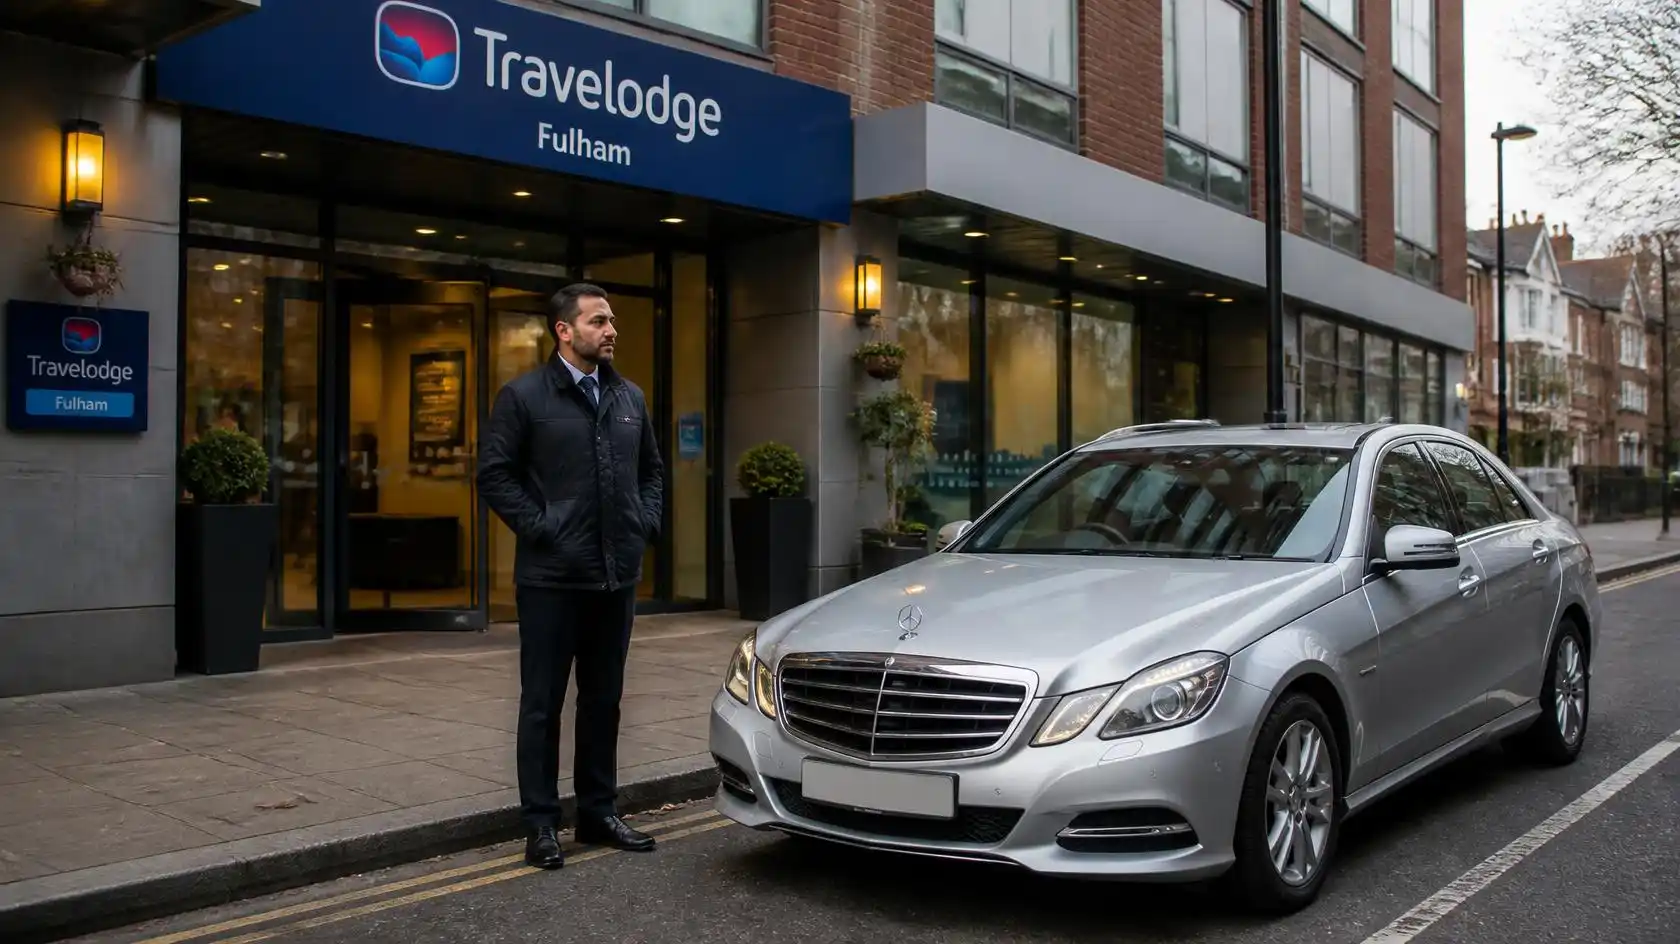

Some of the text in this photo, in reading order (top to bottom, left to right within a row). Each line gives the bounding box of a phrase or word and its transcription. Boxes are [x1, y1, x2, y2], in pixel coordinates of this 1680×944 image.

[474, 27, 722, 143] Travelodge
[538, 122, 631, 166] Fulham
[27, 355, 133, 385] Travelodge
[55, 396, 108, 411] Fulham
